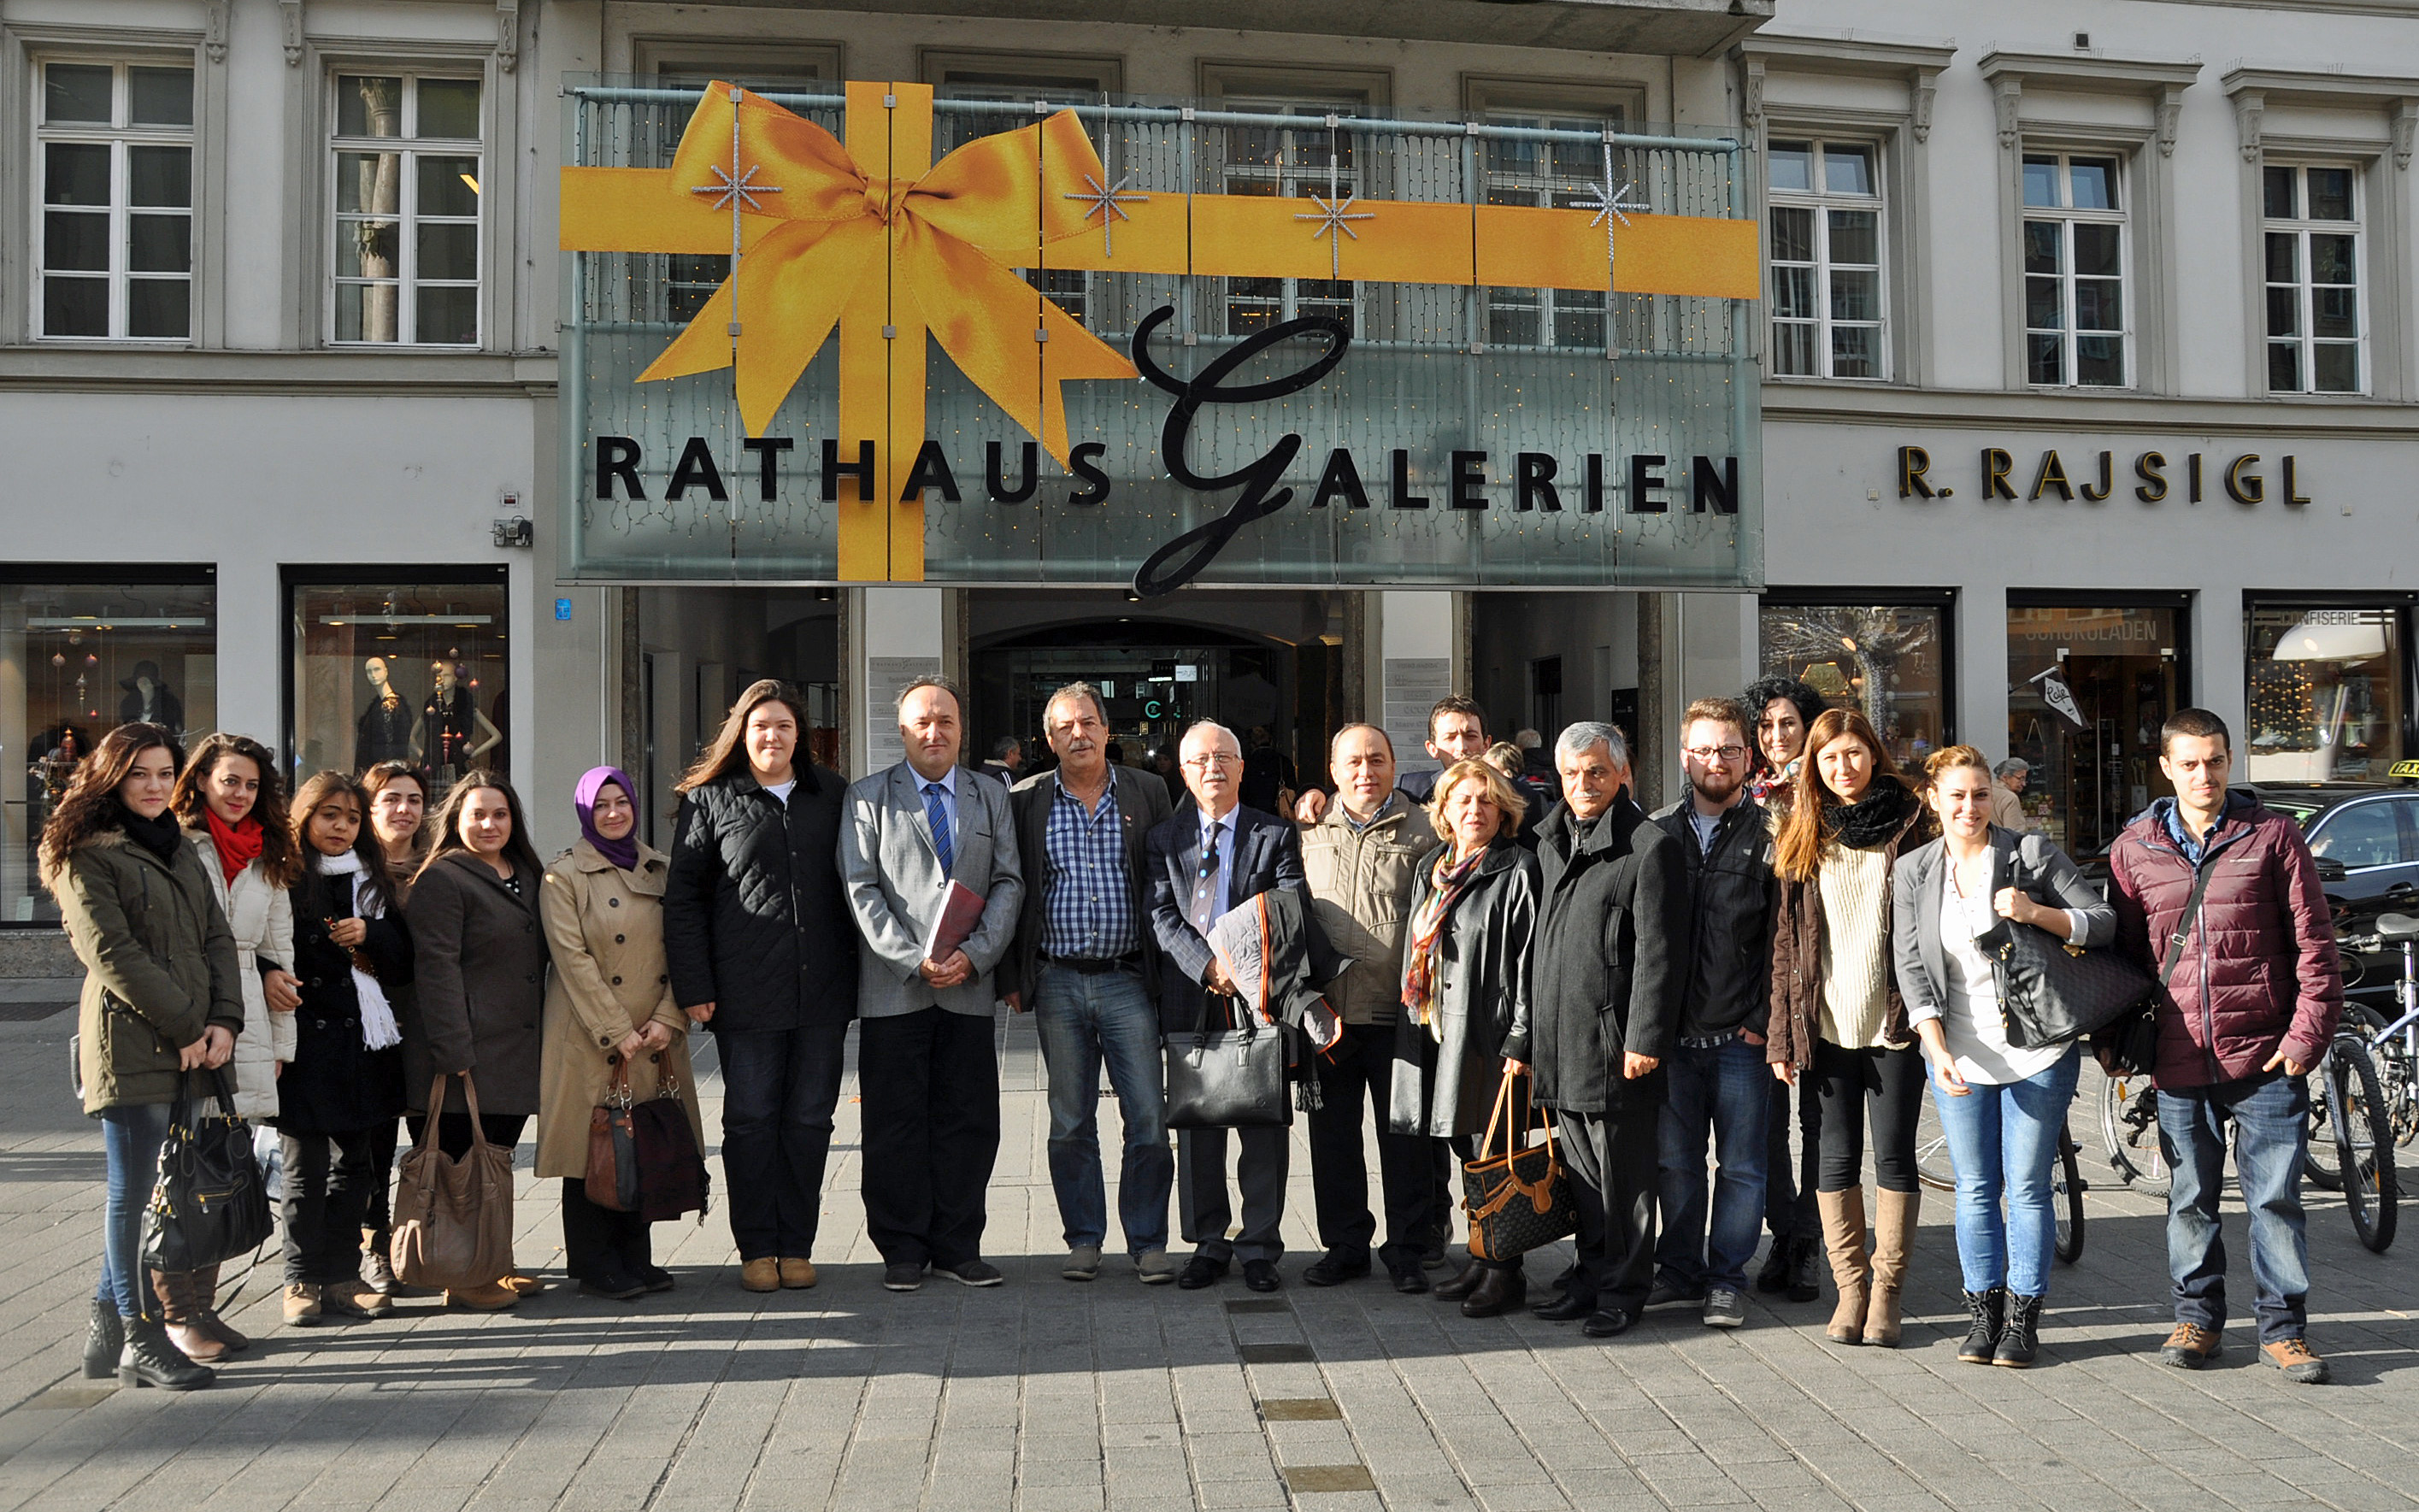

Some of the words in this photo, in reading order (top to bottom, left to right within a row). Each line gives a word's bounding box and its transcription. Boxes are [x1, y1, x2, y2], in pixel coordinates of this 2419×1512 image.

[596, 436, 1112, 506] RATHAUS
[1131, 304, 1739, 597] GALERIEN
[1898, 445, 1955, 500] R.
[1981, 447, 2312, 506] RAJSIGL
[2394, 762, 2419, 774] TAX
